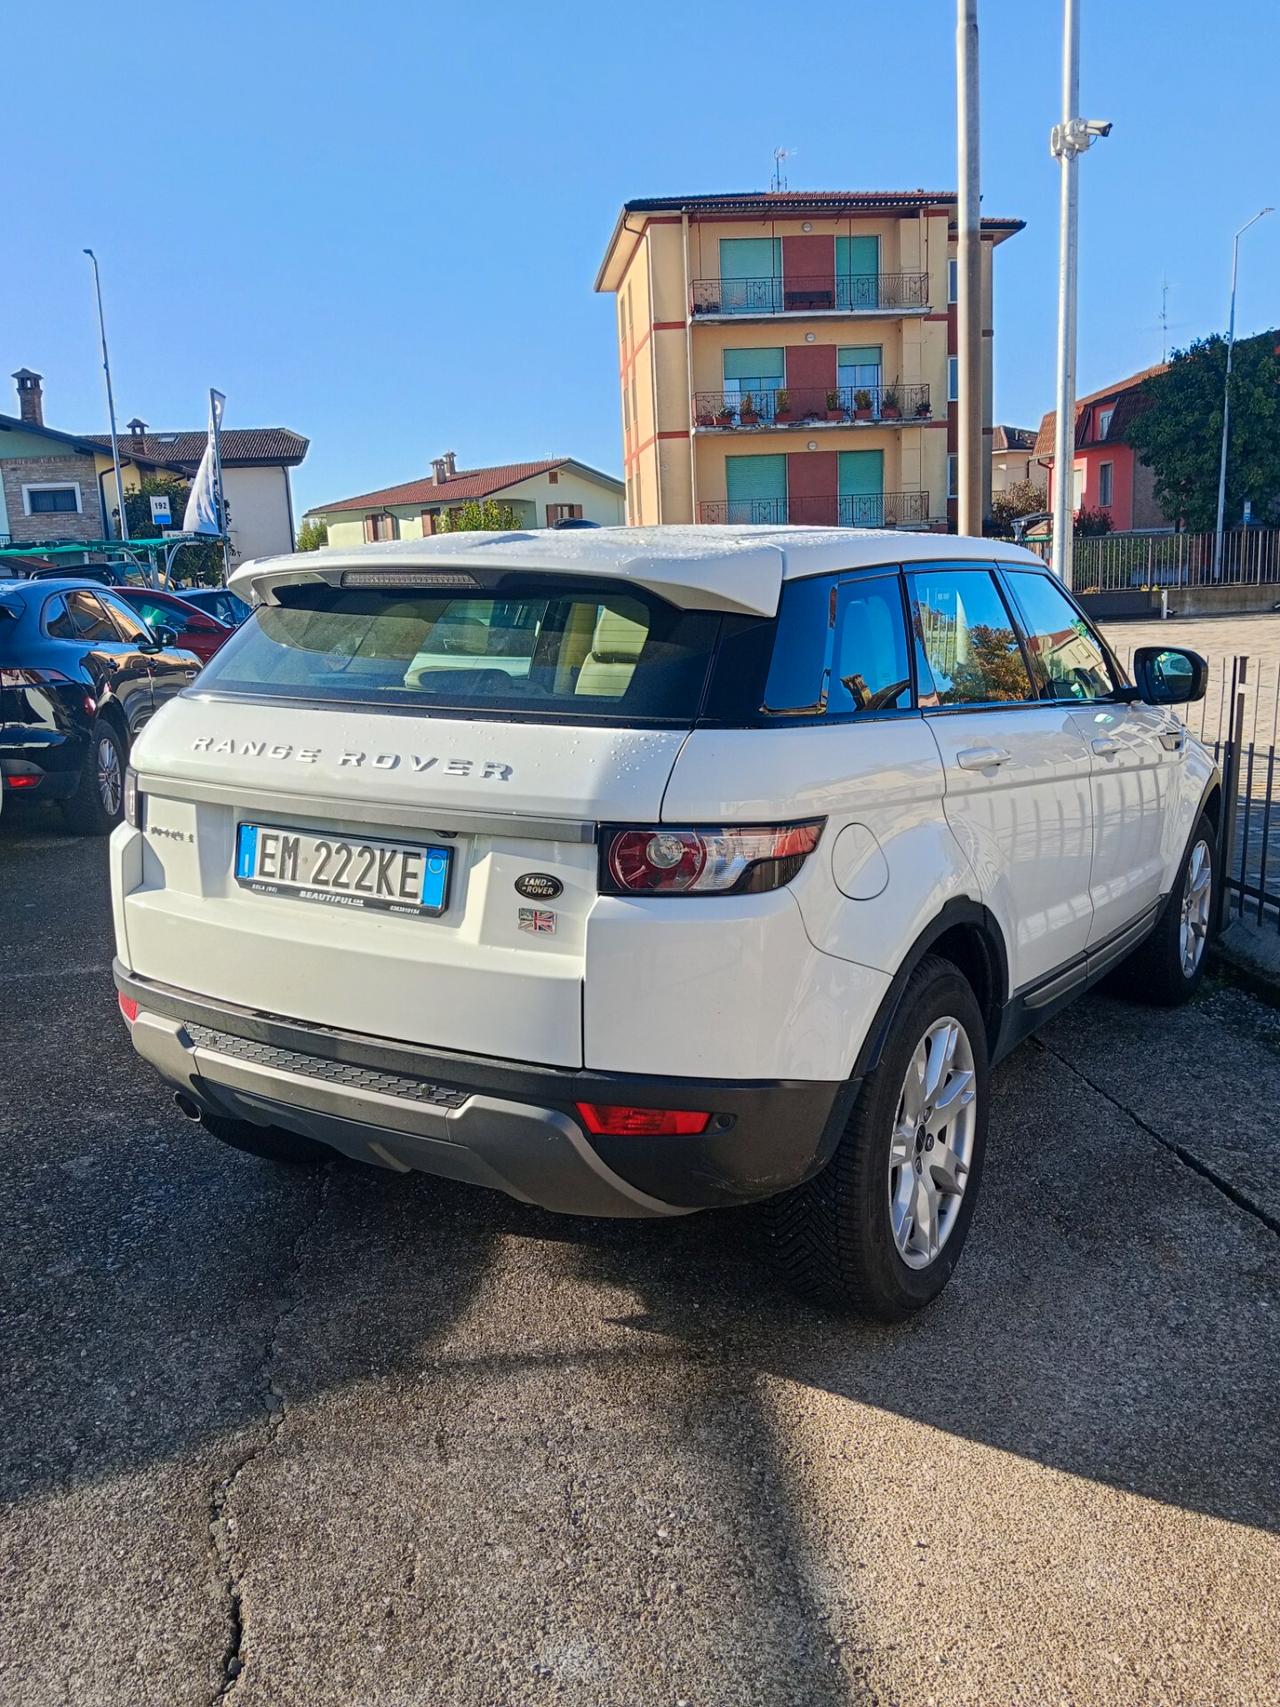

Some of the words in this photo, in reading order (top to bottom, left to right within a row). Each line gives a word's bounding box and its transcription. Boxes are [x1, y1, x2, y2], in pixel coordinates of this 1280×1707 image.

[154, 502, 167, 510] 192
[191, 736, 322, 763] RANGE
[338, 749, 514, 781] ROVER
[258, 833, 301, 882] EM
[311, 840, 422, 899] 222KE
